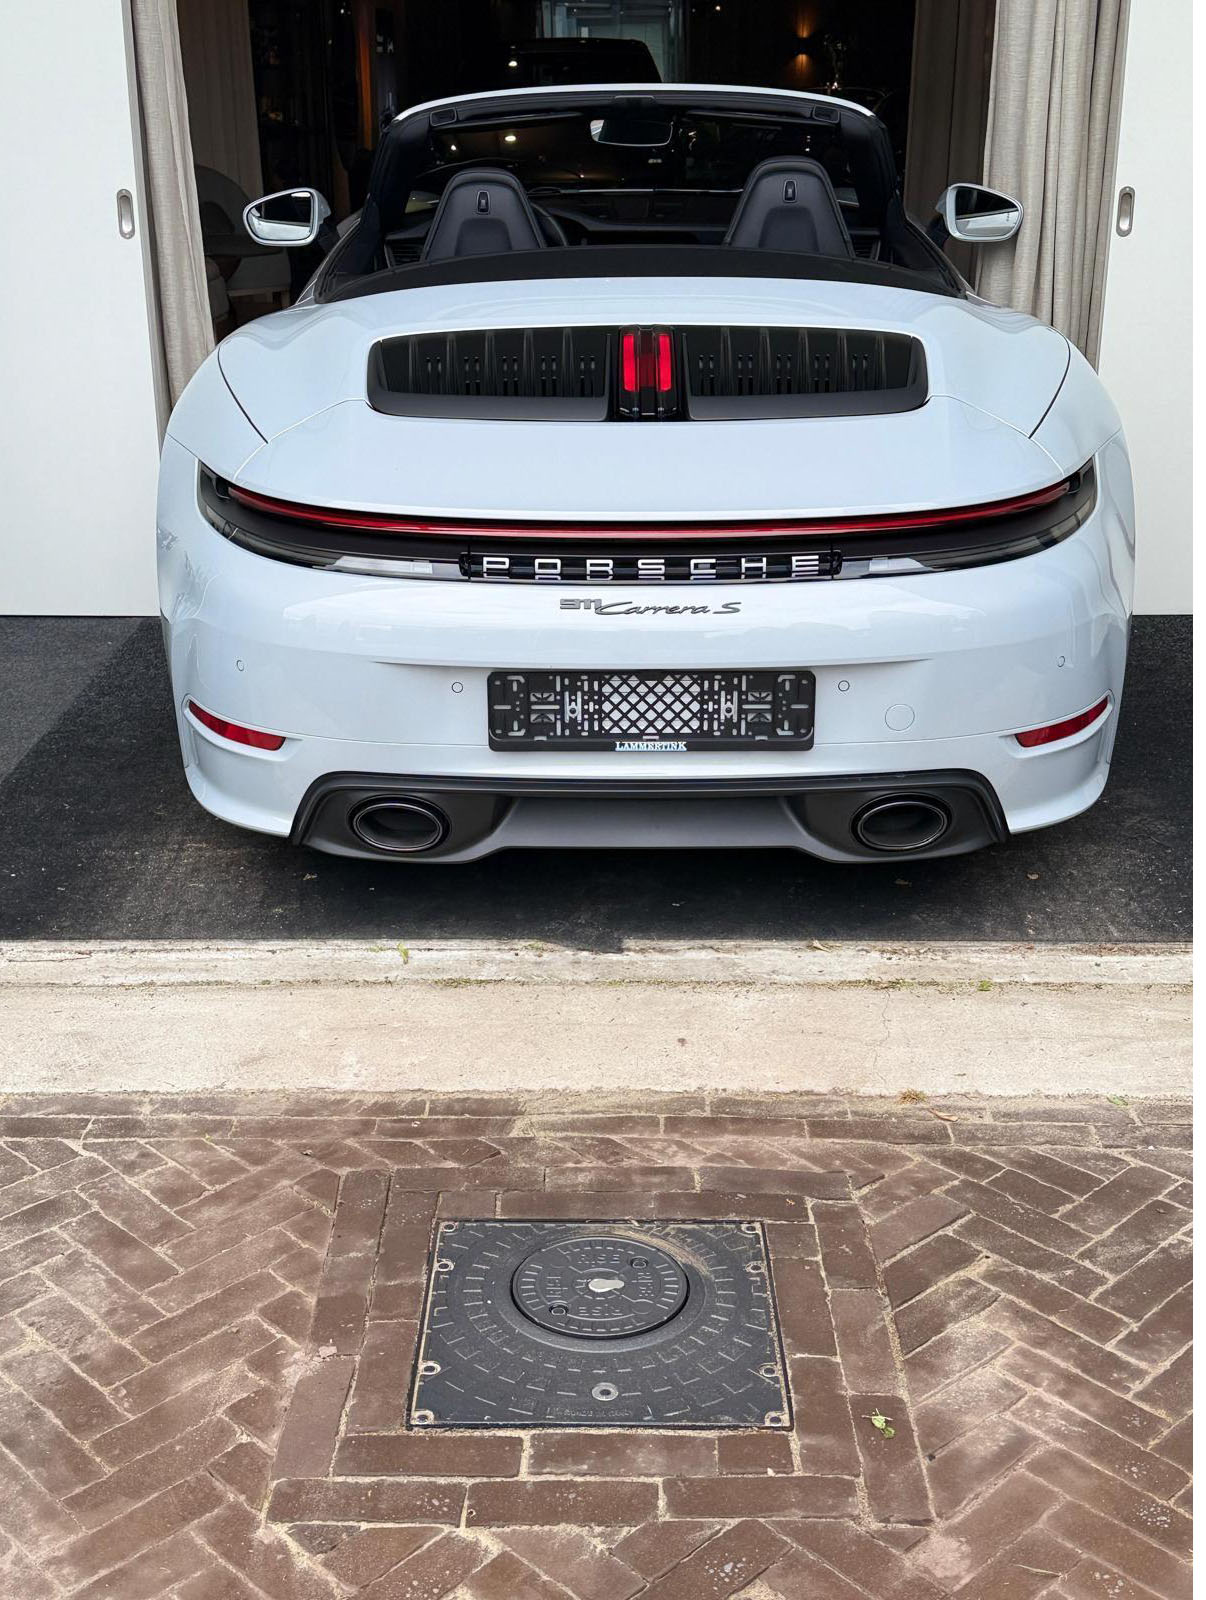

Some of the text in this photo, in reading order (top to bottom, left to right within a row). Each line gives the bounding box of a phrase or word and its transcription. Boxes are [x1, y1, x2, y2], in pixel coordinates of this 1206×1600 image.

[482, 555, 820, 575] PORSCHE
[560, 598, 742, 615] 911 Carrera S
[615, 741, 687, 752] LAMMERTINK
[577, 1254, 621, 1265] RISE
